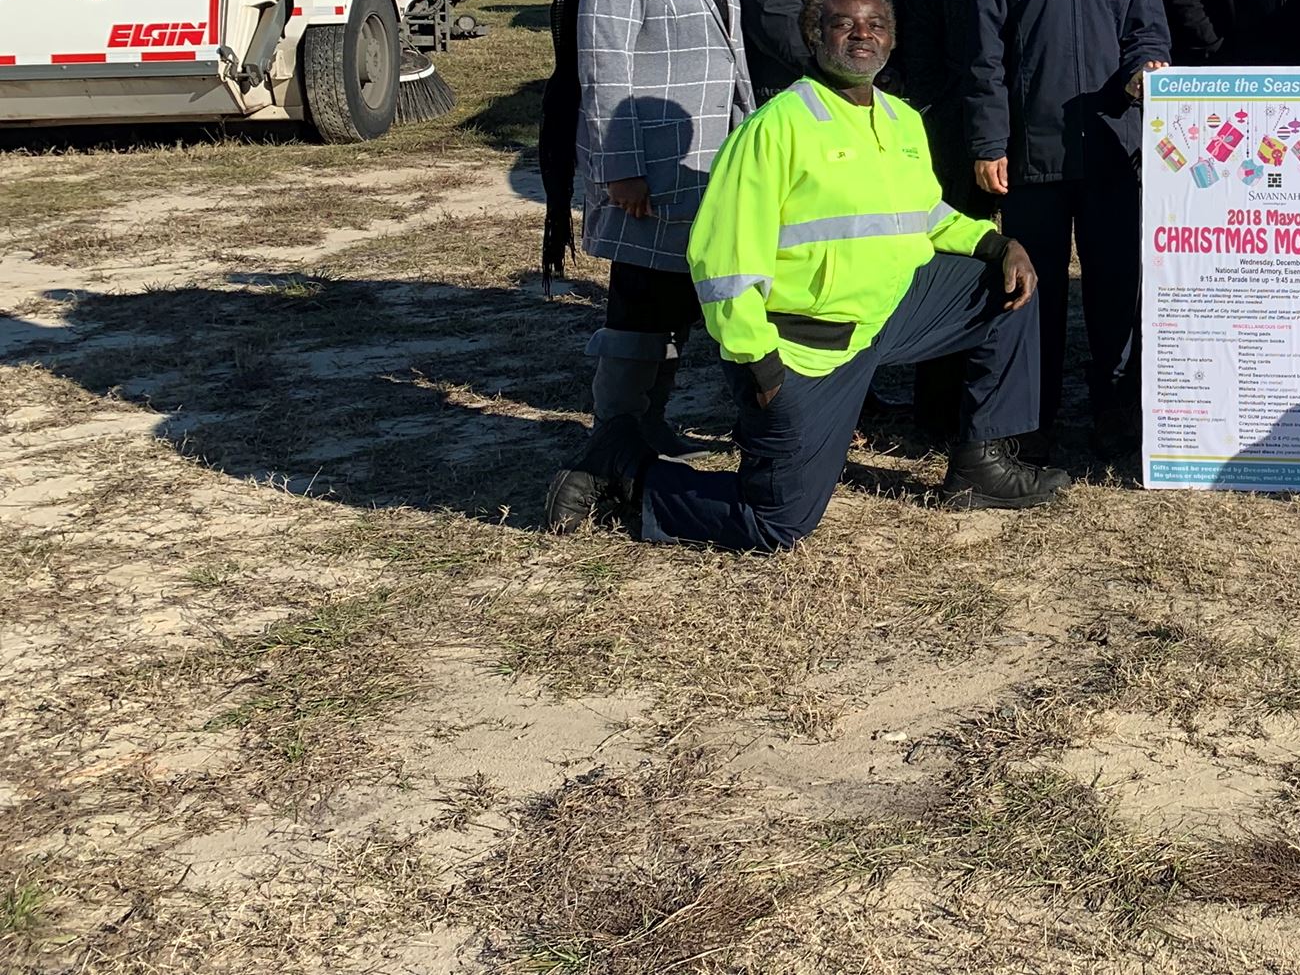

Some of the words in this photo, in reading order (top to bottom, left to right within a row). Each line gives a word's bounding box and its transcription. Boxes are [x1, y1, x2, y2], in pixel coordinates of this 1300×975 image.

[107, 22, 207, 47] ELGIN
[1158, 78, 1230, 93] Celebrate
[1236, 78, 1258, 93] the
[1248, 191, 1300, 201] SAVANNAH
[1227, 210, 1261, 226] 2018
[1154, 226, 1268, 254] CHRISTMAS
